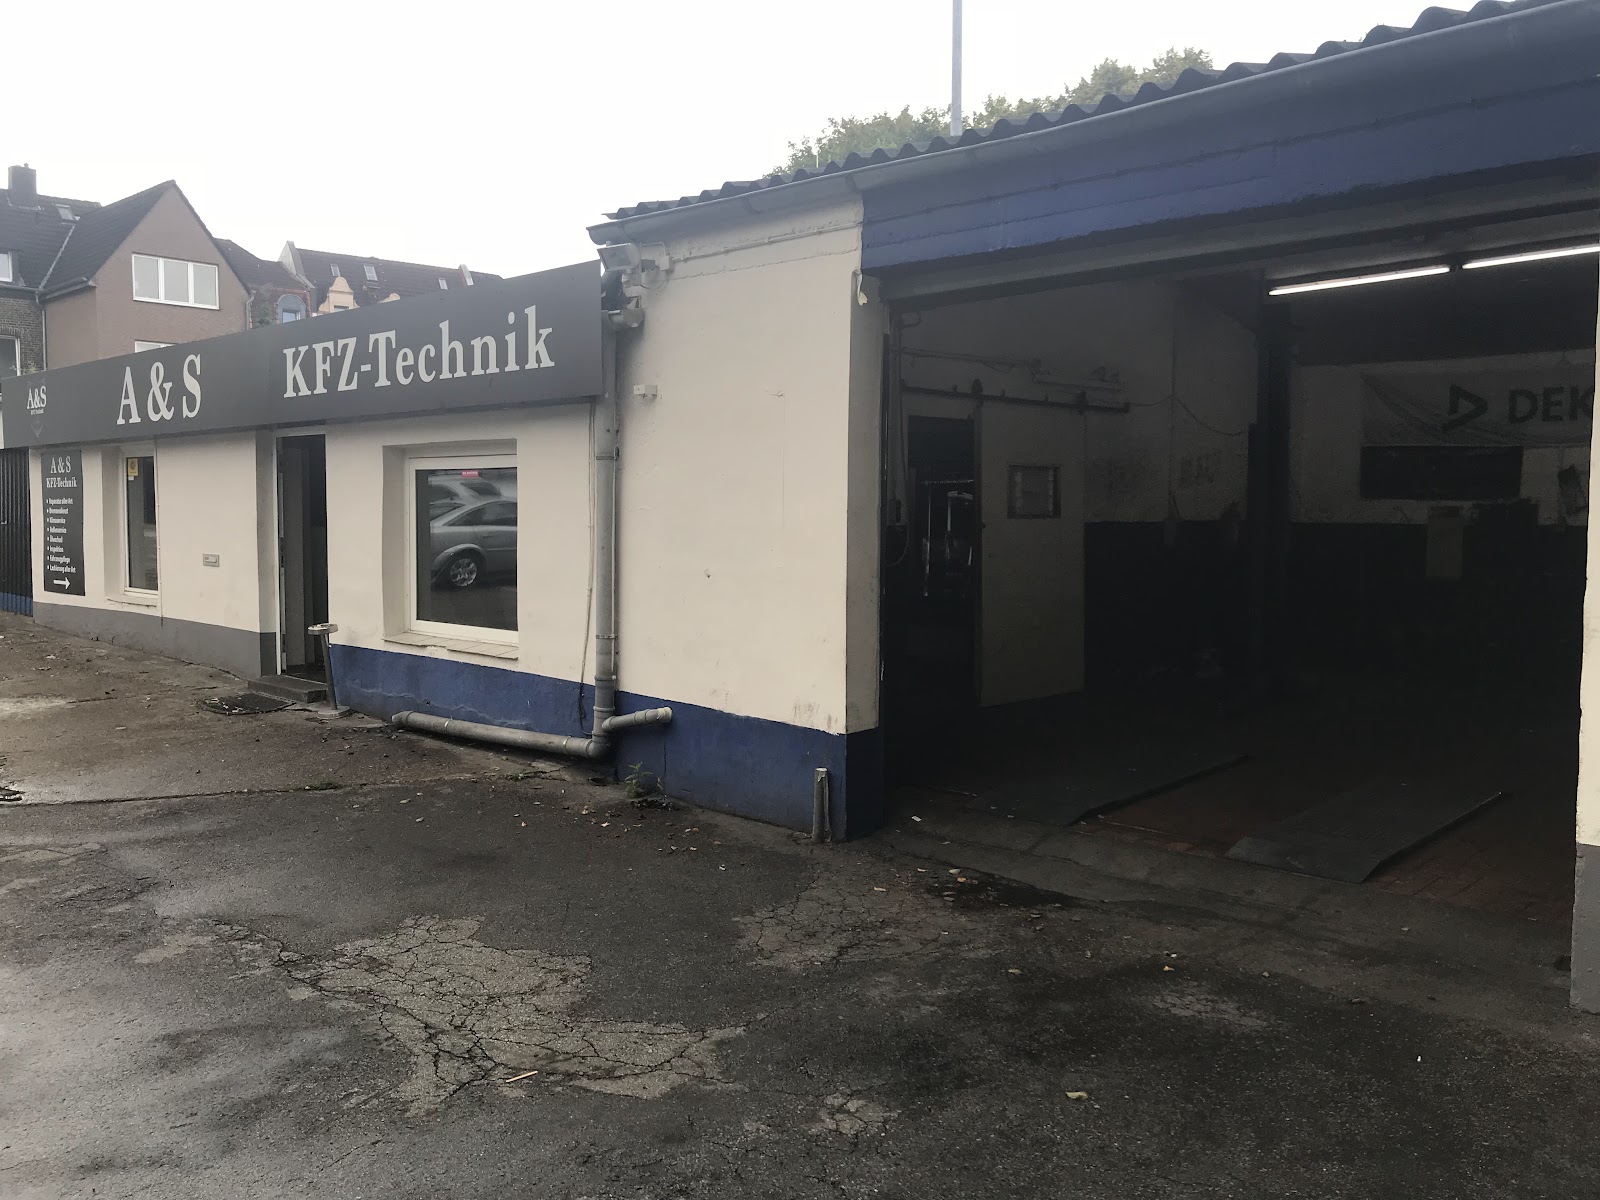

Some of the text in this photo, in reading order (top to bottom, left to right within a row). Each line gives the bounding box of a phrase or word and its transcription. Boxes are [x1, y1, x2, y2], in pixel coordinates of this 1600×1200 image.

[282, 305, 556, 398] KFZ-Technik
[26, 385, 47, 409] A&S
[116, 354, 203, 426] A & S
[50, 456, 72, 474] A & S
[46, 477, 77, 488] KFZ-Technik
